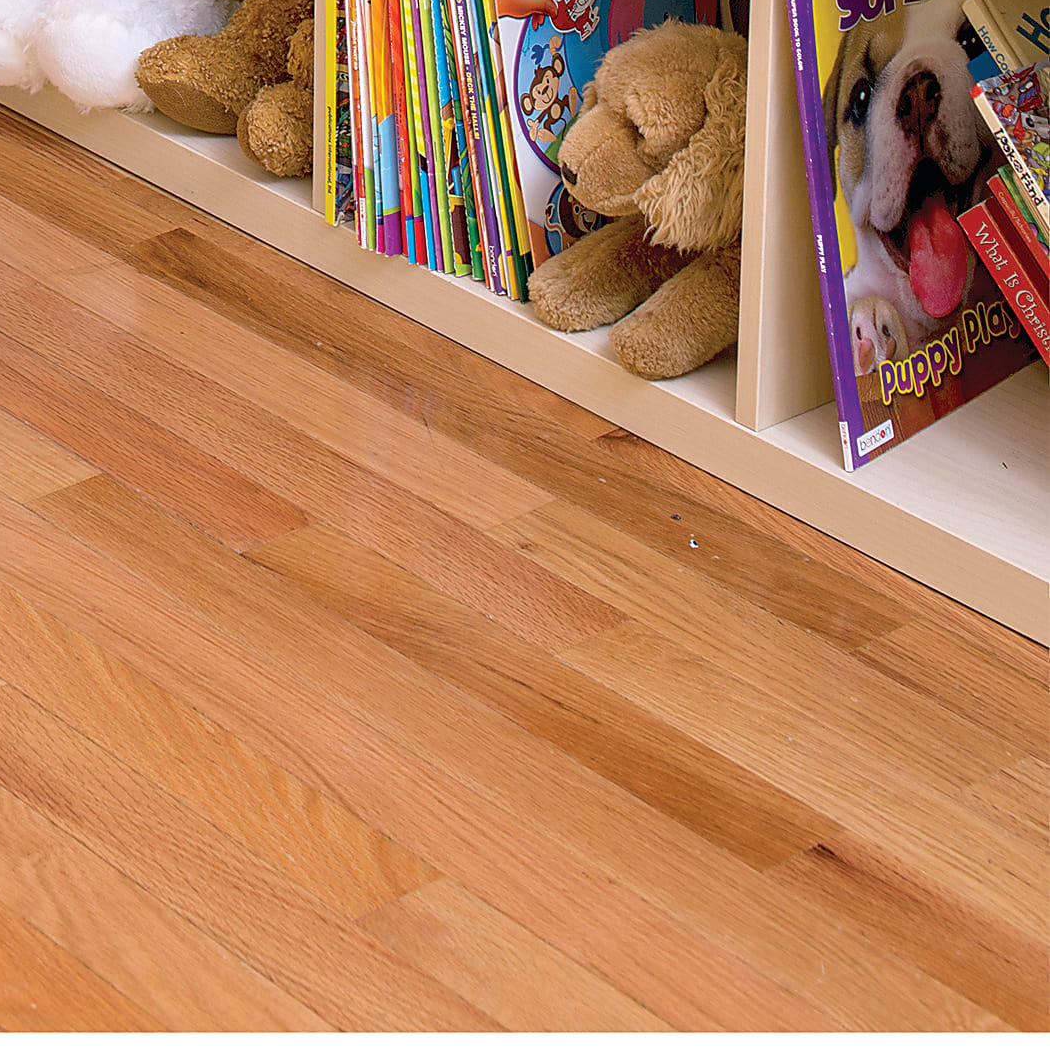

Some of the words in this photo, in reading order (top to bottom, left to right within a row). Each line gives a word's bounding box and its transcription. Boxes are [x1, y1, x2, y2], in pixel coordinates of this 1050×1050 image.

[457, 5, 466, 37] MICKEY
[461, 37, 471, 66] MOUSE
[465, 71, 475, 93] DECK
[975, 221, 1009, 271] What
[1003, 271, 1020, 289] Is
[879, 326, 963, 405] Puppy
[859, 424, 892, 451] bendon
